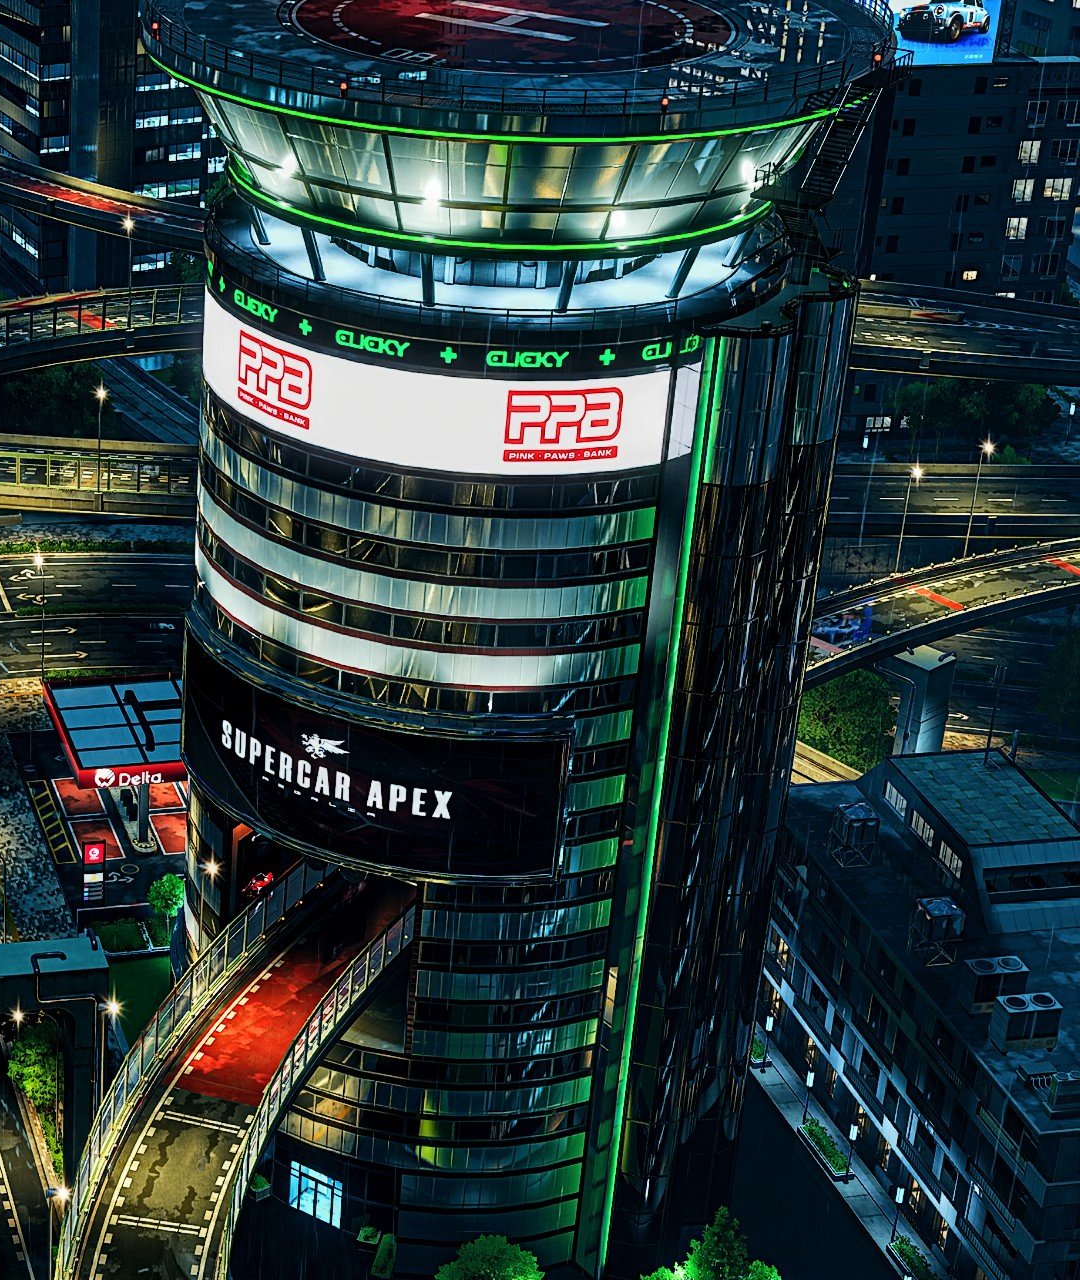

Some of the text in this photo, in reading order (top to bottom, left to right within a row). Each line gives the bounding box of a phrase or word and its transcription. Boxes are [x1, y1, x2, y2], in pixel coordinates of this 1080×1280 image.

[414, 0, 610, 42] H
[335, 329, 410, 357] CLICKY
[486, 350, 569, 368] CLICKY
[238, 330, 313, 410] PPB
[504, 387, 624, 444] PPB
[508, 448, 613, 460] PINK PAWS BANK
[221, 720, 351, 802] SUPERCAR
[366, 780, 453, 820] APEX
